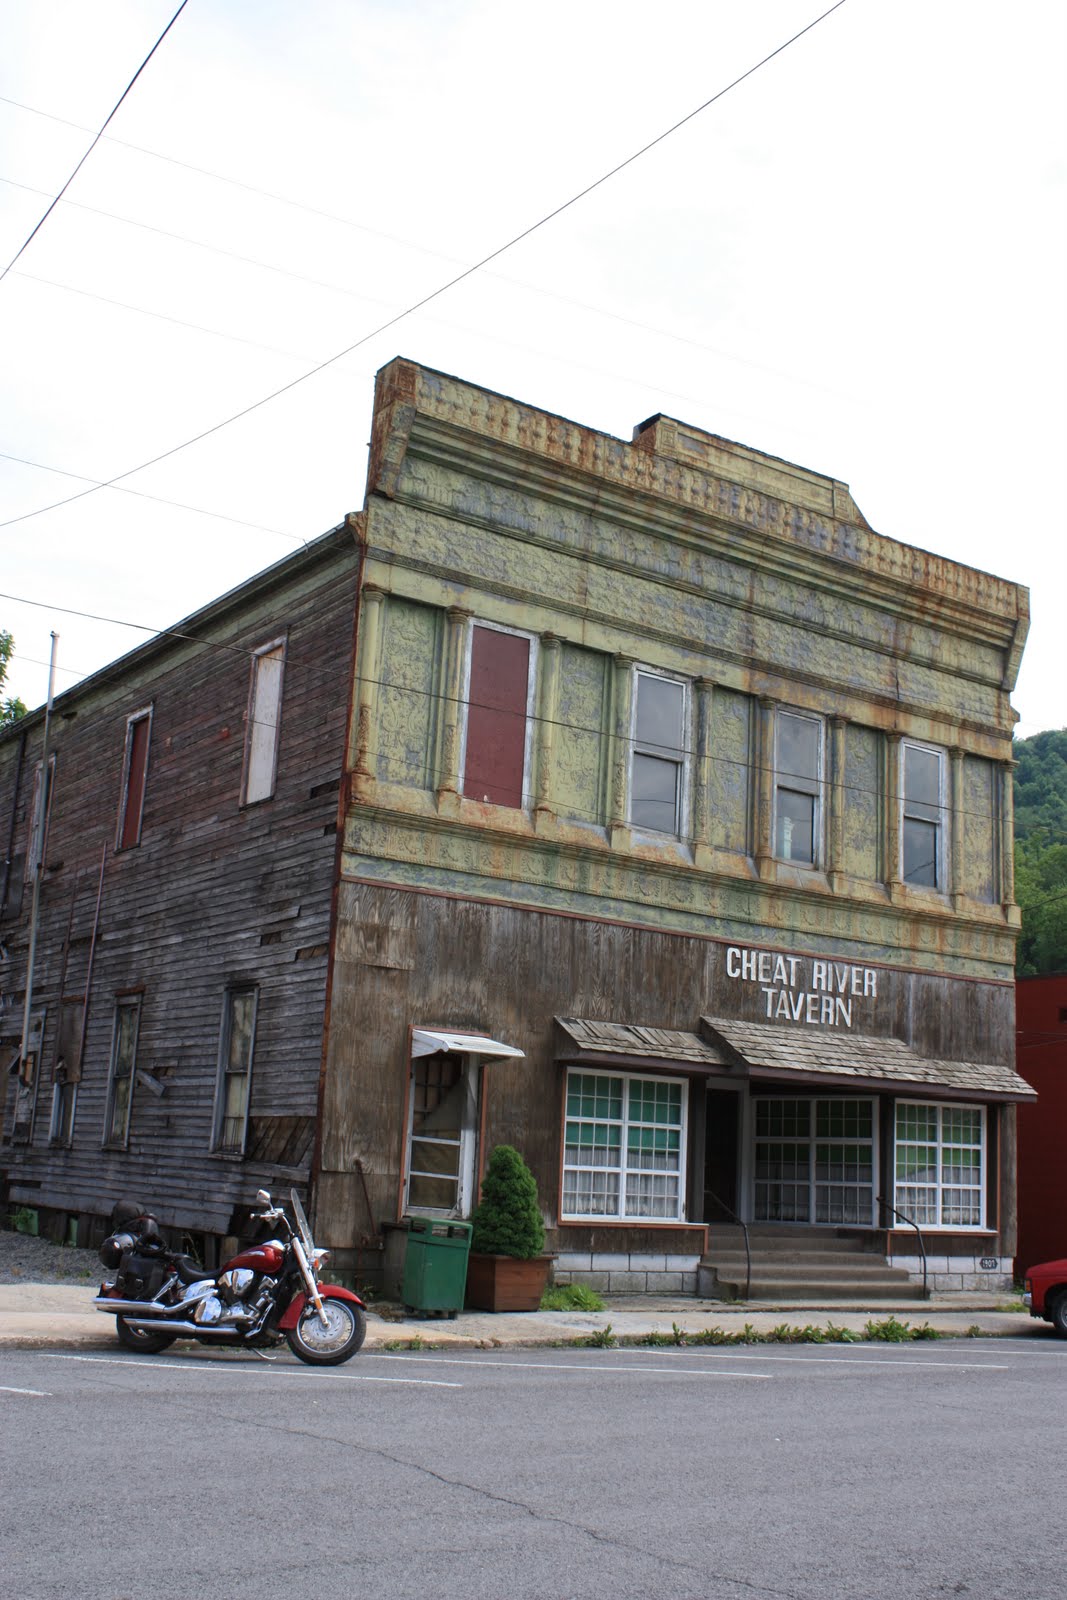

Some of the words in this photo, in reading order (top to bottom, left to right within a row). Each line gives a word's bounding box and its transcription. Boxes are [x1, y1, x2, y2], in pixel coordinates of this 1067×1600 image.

[727, 947, 801, 987] CHEAT
[812, 960, 877, 997] RIVER
[761, 987, 852, 1027] TAVERN
